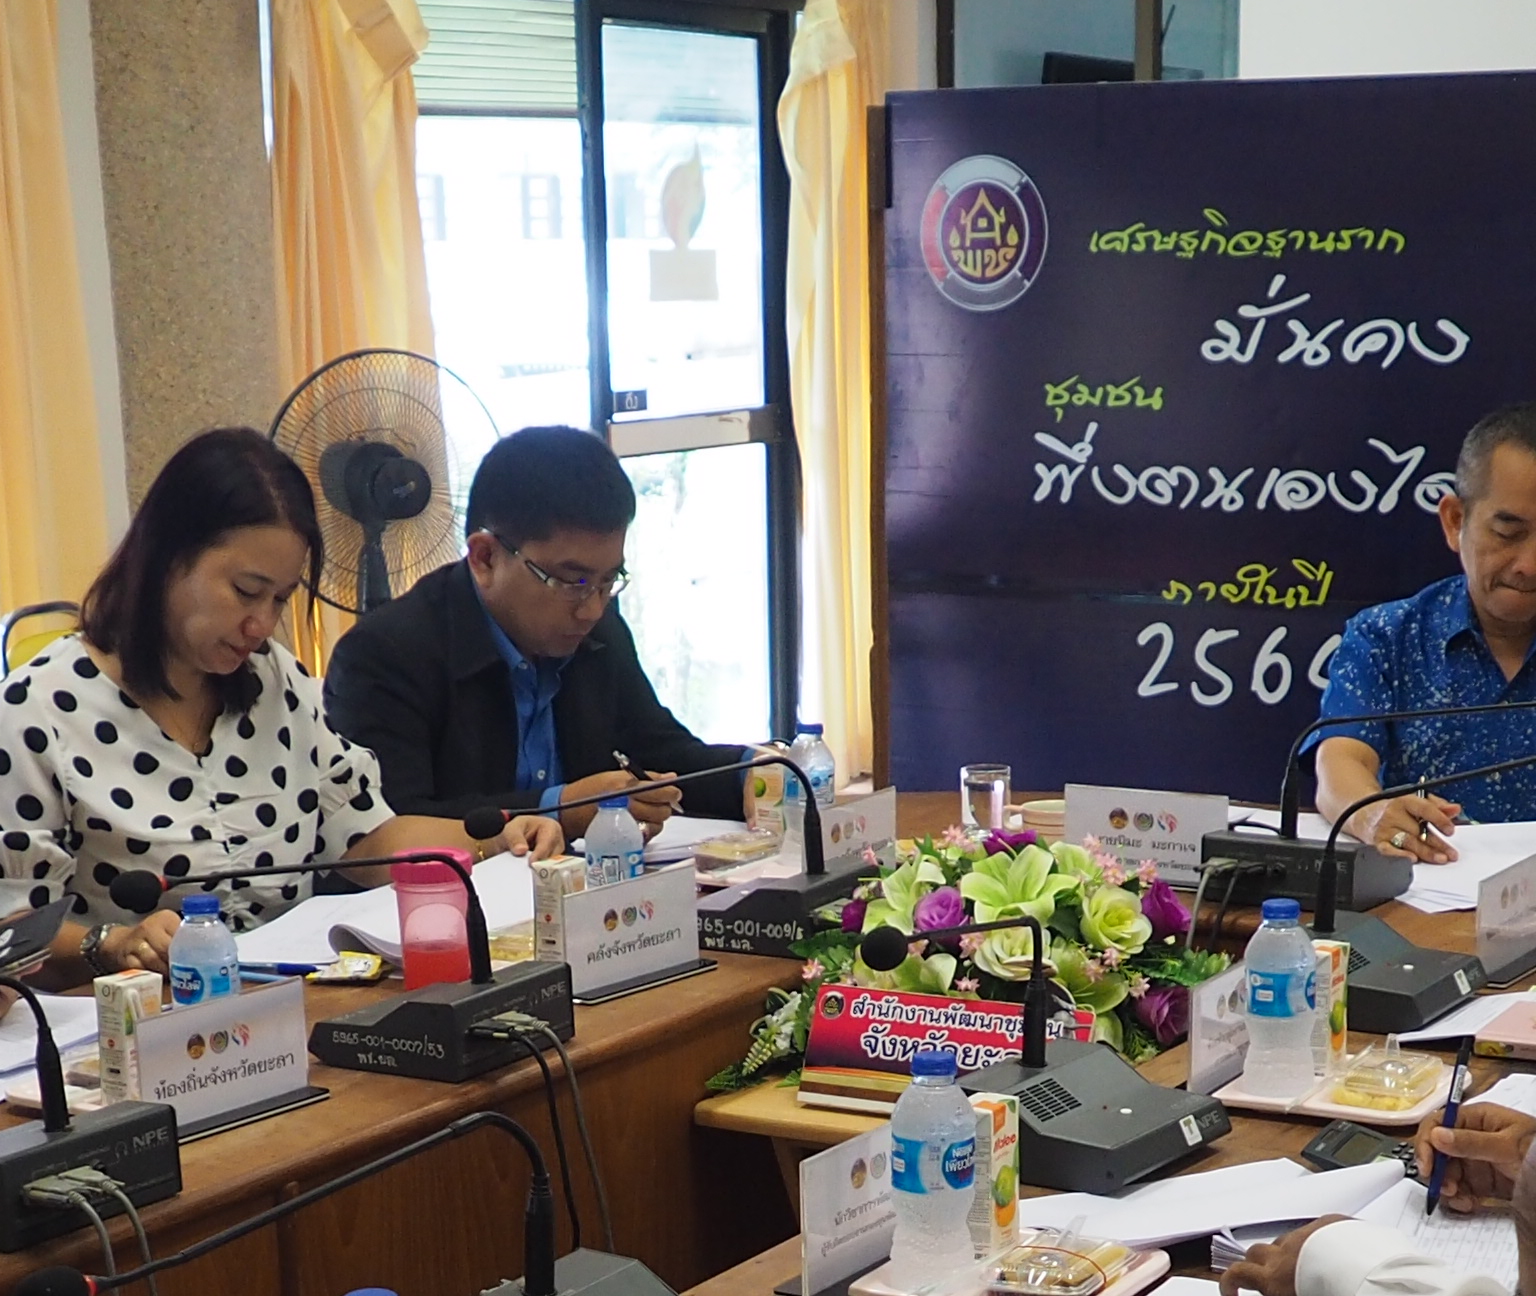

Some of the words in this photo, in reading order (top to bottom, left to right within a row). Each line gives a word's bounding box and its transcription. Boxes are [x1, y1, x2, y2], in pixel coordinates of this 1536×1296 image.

[1089, 209, 1405, 261] เศรษฐกิจฐานราก
[1201, 275, 1471, 369] มั่นคง
[1044, 375, 1164, 422] ชุมชน
[1163, 561, 1333, 608] ภายในปี
[587, 927, 682, 965] คลังจังหวัดยะลา
[541, 980, 567, 999] NPE
[154, 1052, 296, 1100] ท้องถิ่นจังหวัดยะลา
[132, 1126, 170, 1149] NPE
